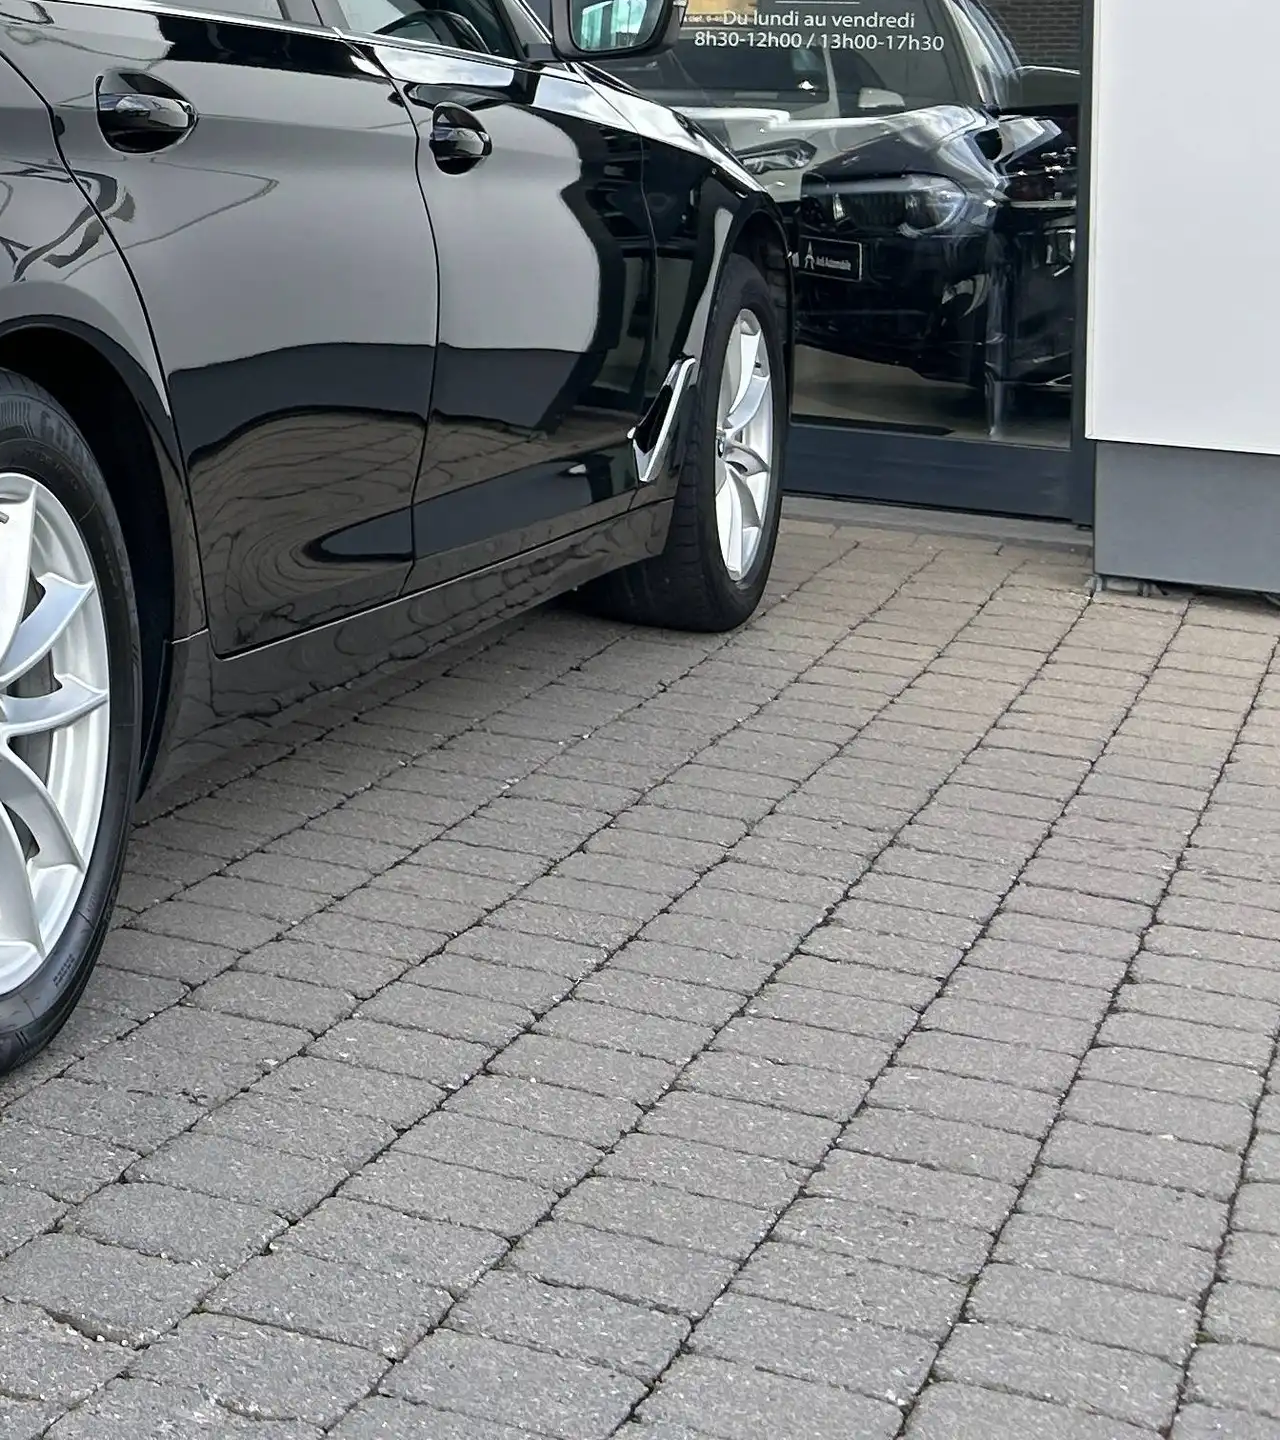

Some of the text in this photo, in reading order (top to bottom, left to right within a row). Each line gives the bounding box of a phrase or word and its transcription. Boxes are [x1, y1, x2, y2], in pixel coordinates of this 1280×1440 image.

[723, 11, 750, 26] Du
[753, 10, 801, 27] lundi
[804, 13, 827, 27] au
[831, 11, 916, 29] vendredi
[693, 31, 803, 49] 8h30-12h00
[820, 33, 945, 52] 13h00-17h30
